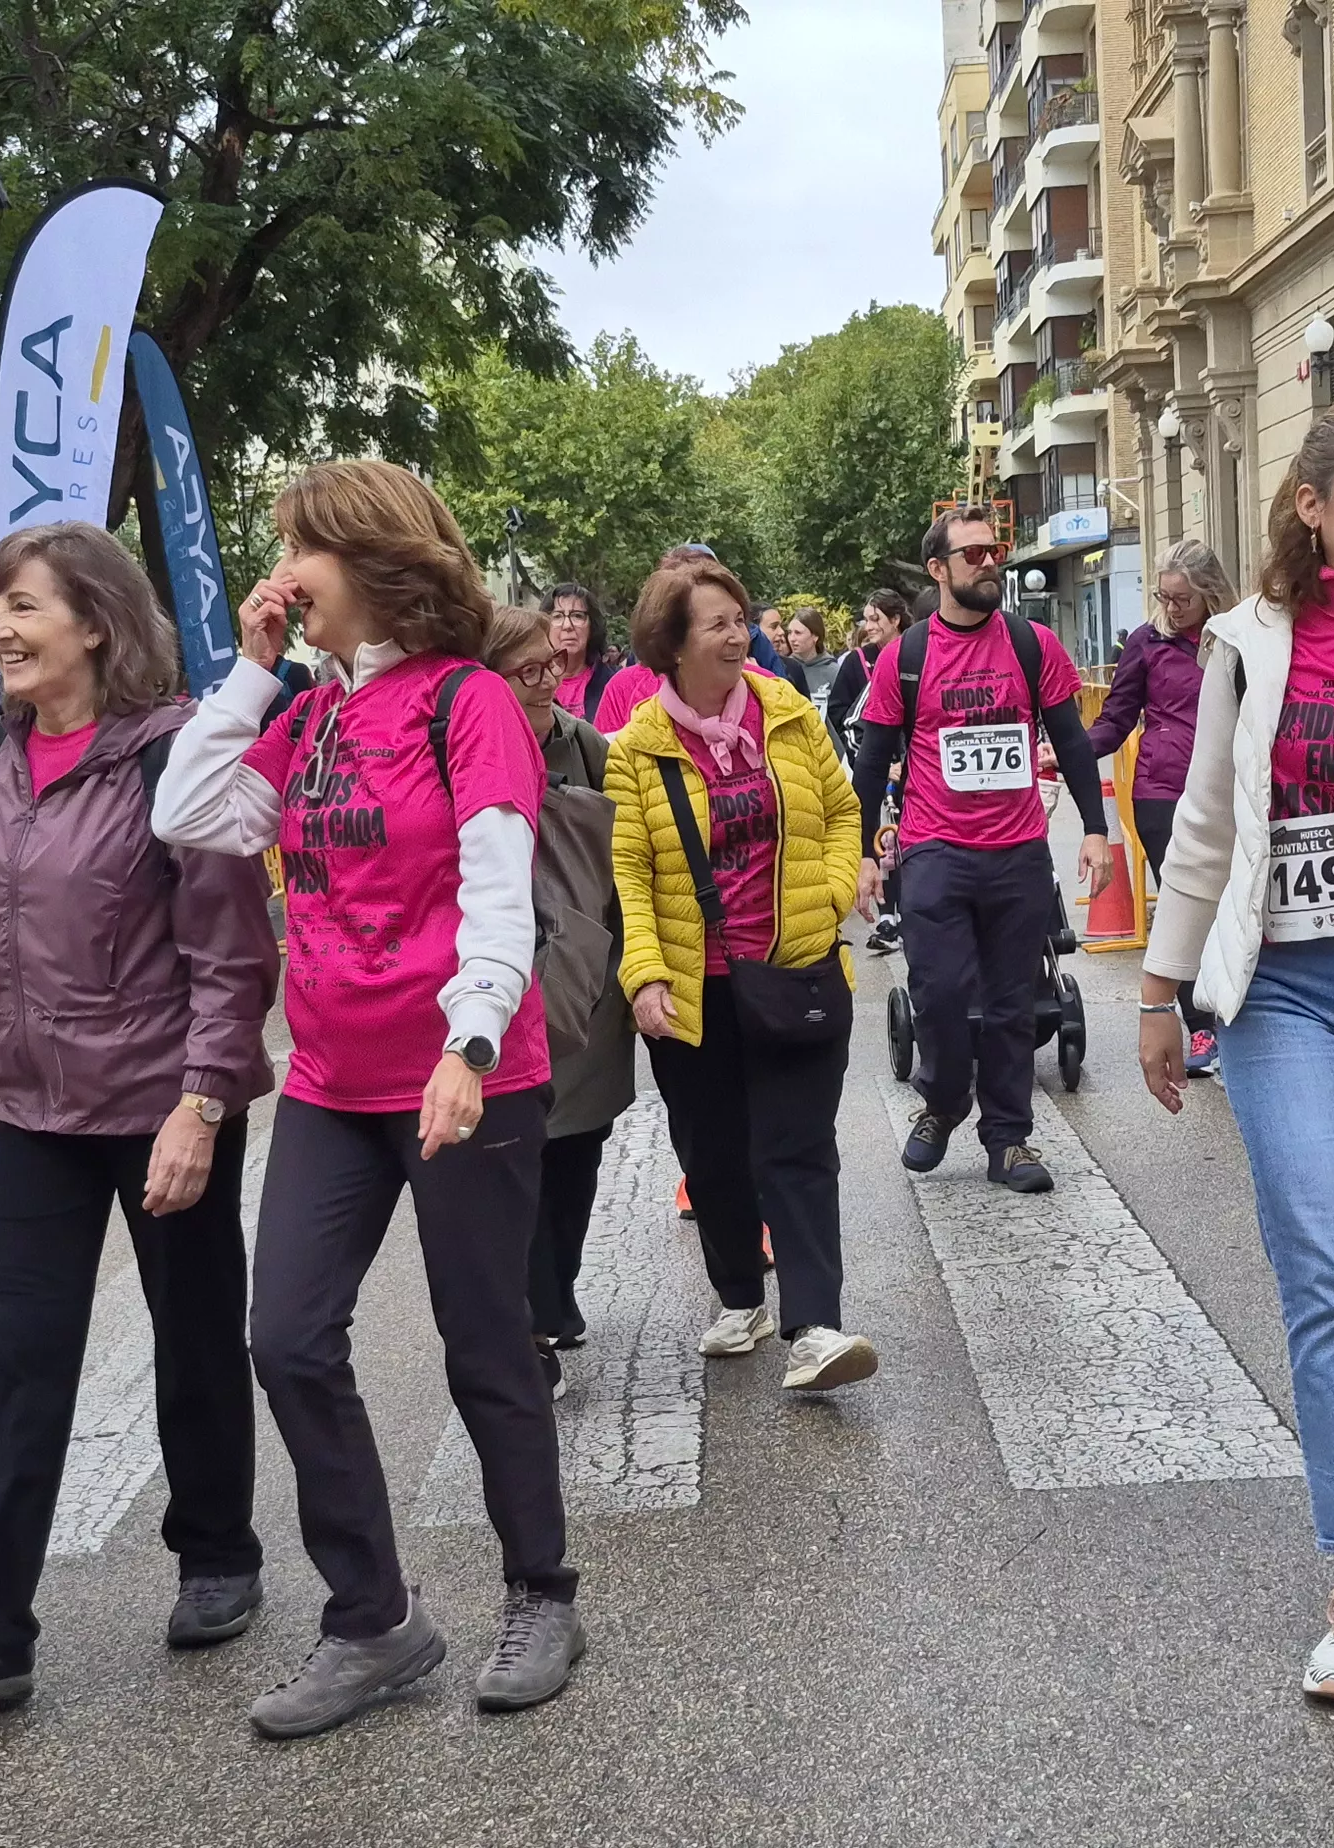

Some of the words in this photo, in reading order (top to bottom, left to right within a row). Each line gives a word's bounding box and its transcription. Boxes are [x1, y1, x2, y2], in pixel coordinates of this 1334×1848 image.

[941, 686, 995, 711] UNIDOS
[951, 746, 1022, 773] 3176
[302, 811, 325, 848] EN
[328, 806, 387, 847] CADA
[1300, 829, 1332, 840] HUESCA
[1271, 842, 1309, 856] CONTRA
[1310, 840, 1323, 851] EL
